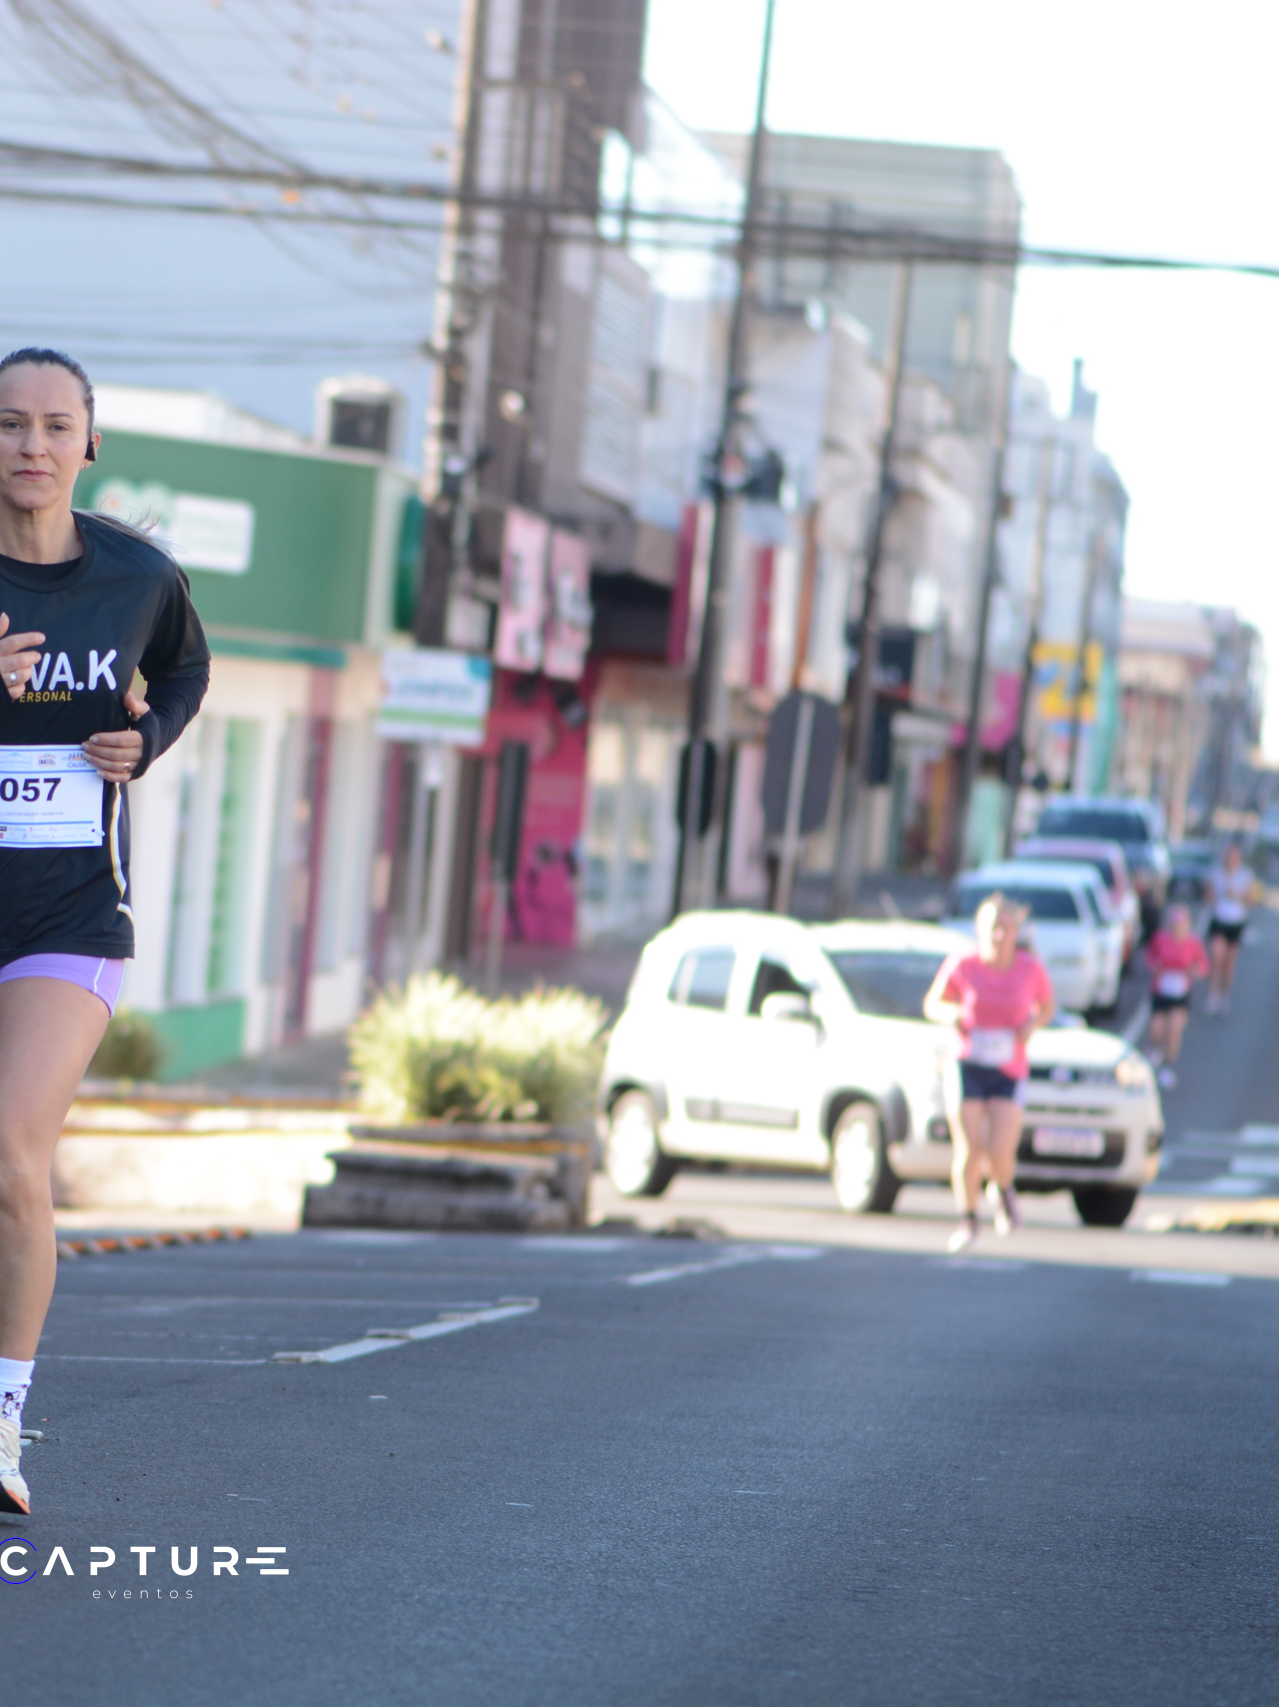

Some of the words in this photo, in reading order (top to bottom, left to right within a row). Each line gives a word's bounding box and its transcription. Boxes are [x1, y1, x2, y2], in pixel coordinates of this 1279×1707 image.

[30, 648, 118, 692] VA.K
[12, 690, 73, 703] ERSONAL
[0, 777, 62, 802] 057
